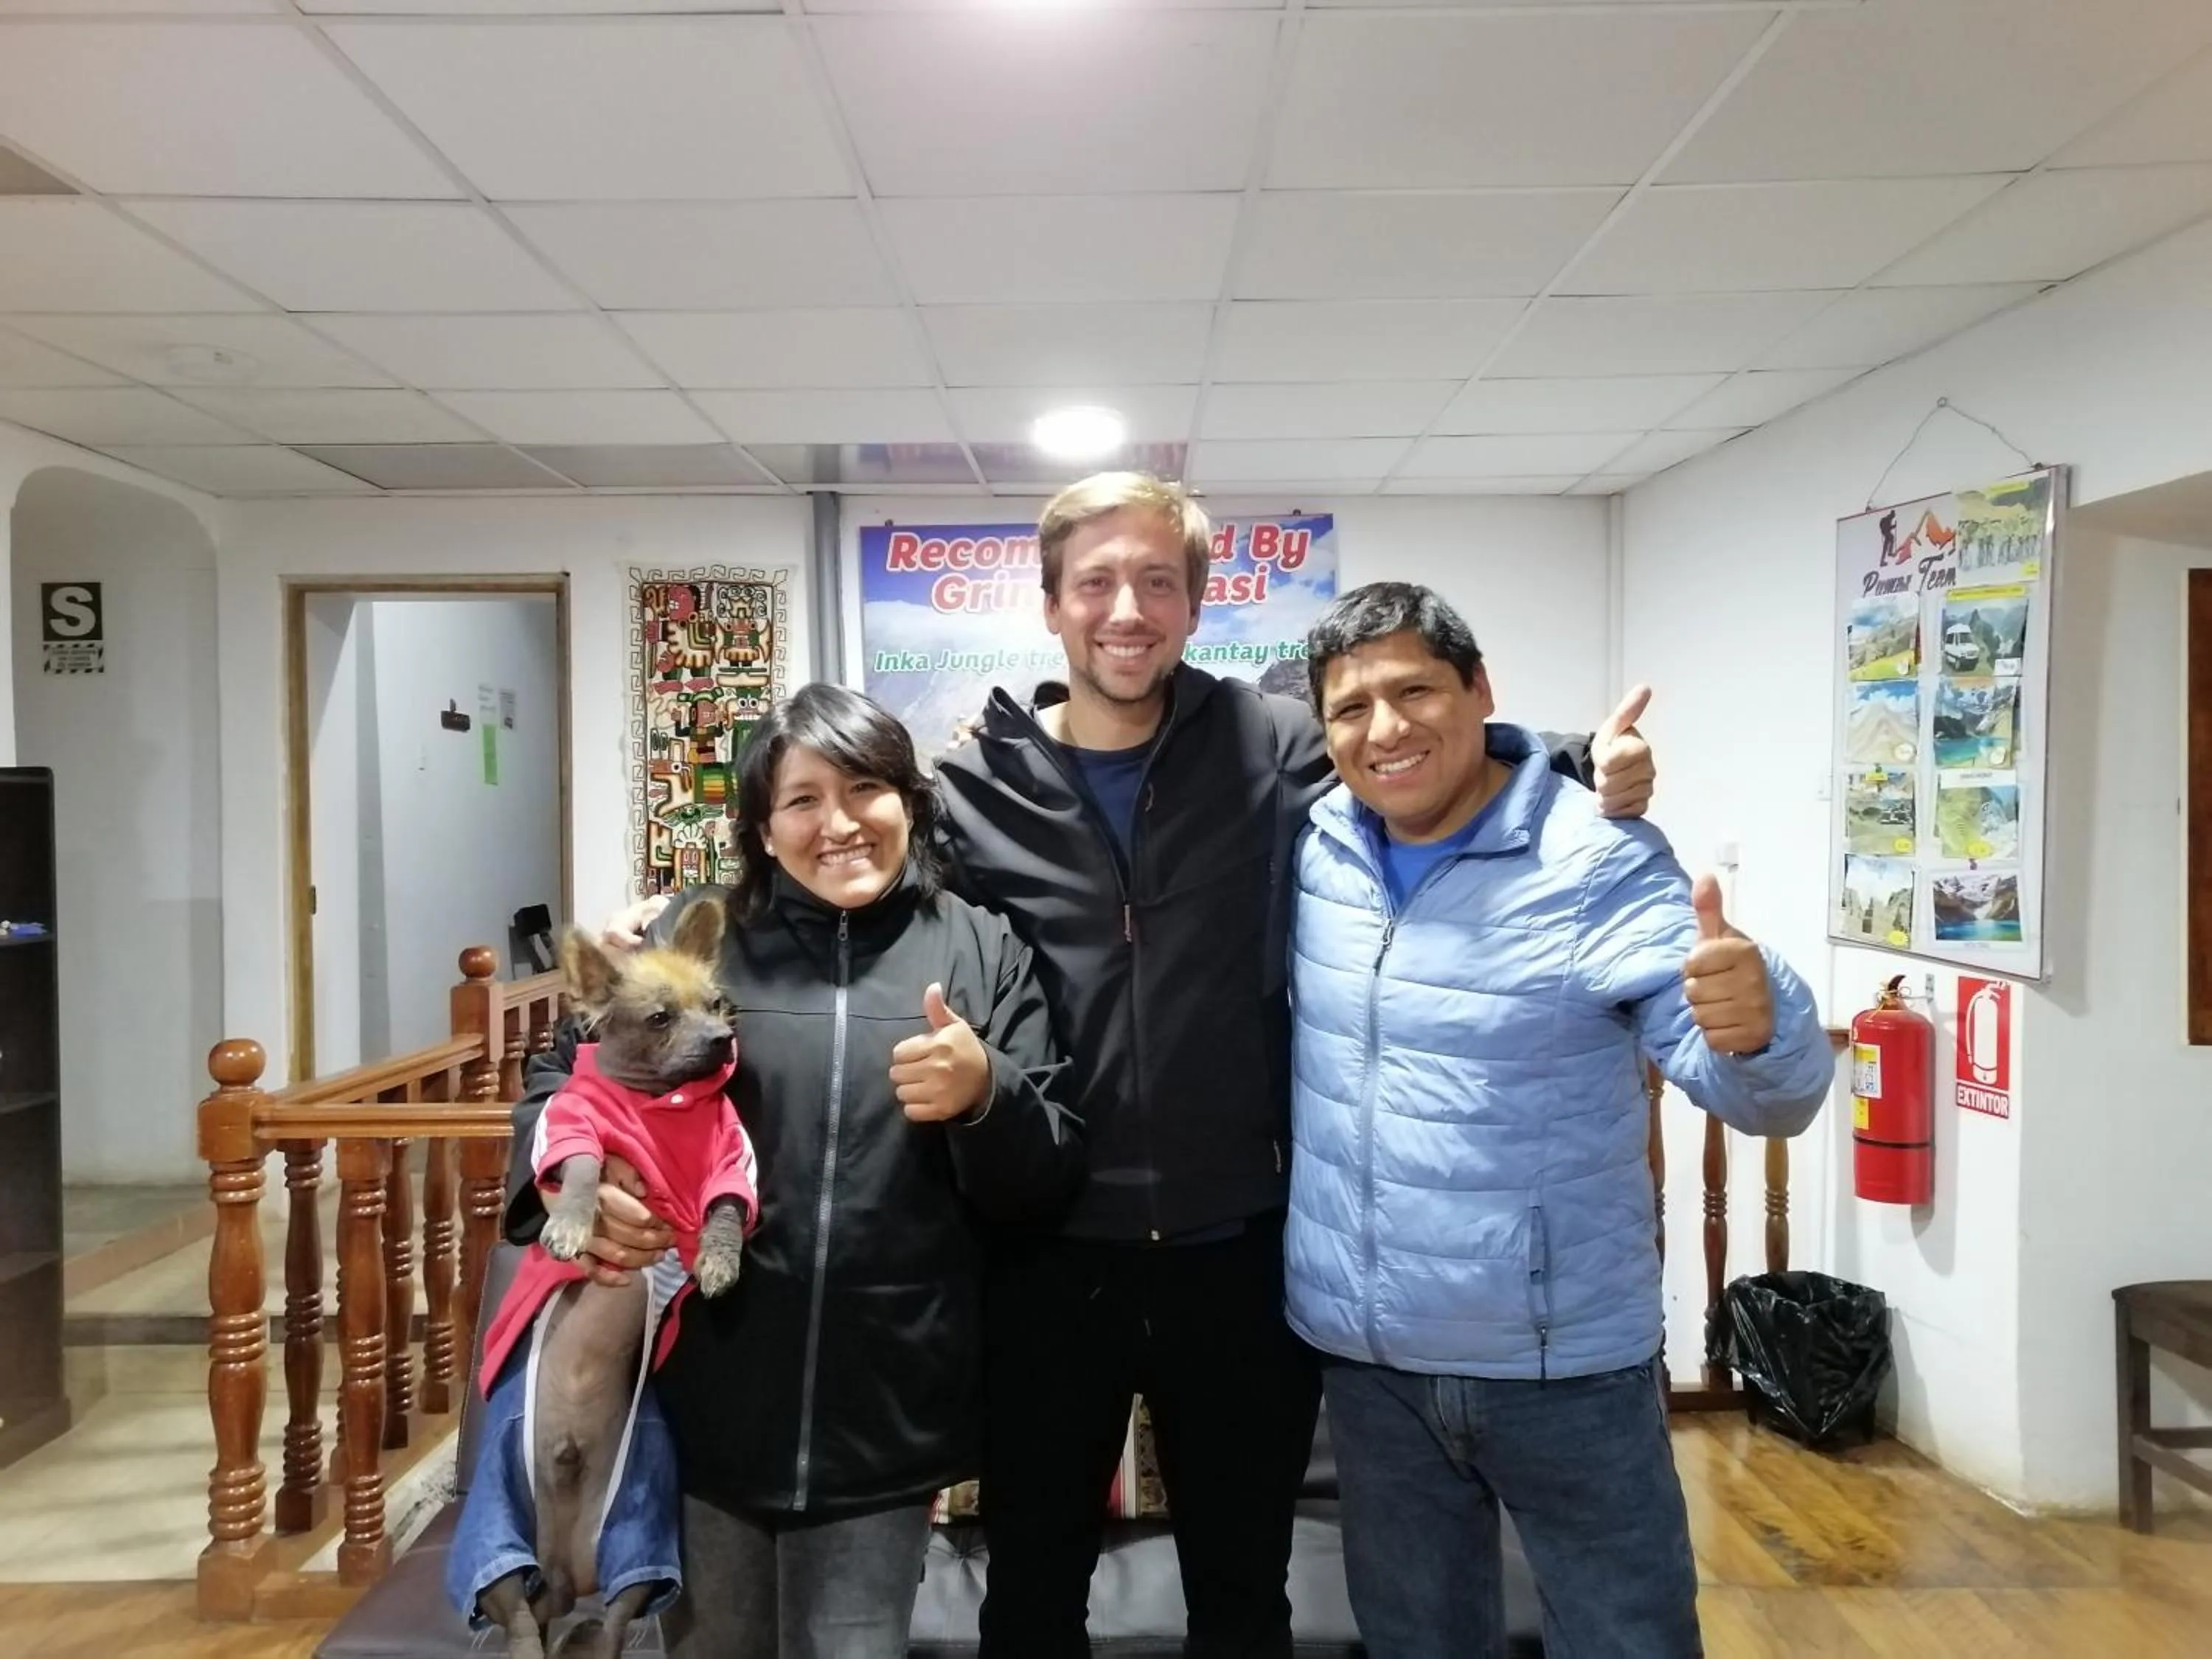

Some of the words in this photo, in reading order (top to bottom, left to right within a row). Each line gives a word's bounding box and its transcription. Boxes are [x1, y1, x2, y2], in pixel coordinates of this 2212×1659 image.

[1251, 524, 1310, 570] By
[933, 571, 1043, 611] Grin
[1203, 564, 1267, 602] asi
[49, 586, 96, 636] S
[875, 650, 928, 671] Inka
[937, 649, 1019, 672] Jungle
[1029, 648, 1066, 667] tre
[1183, 641, 1269, 664] kantay
[1958, 1085, 2008, 1116] EXTINTOR
